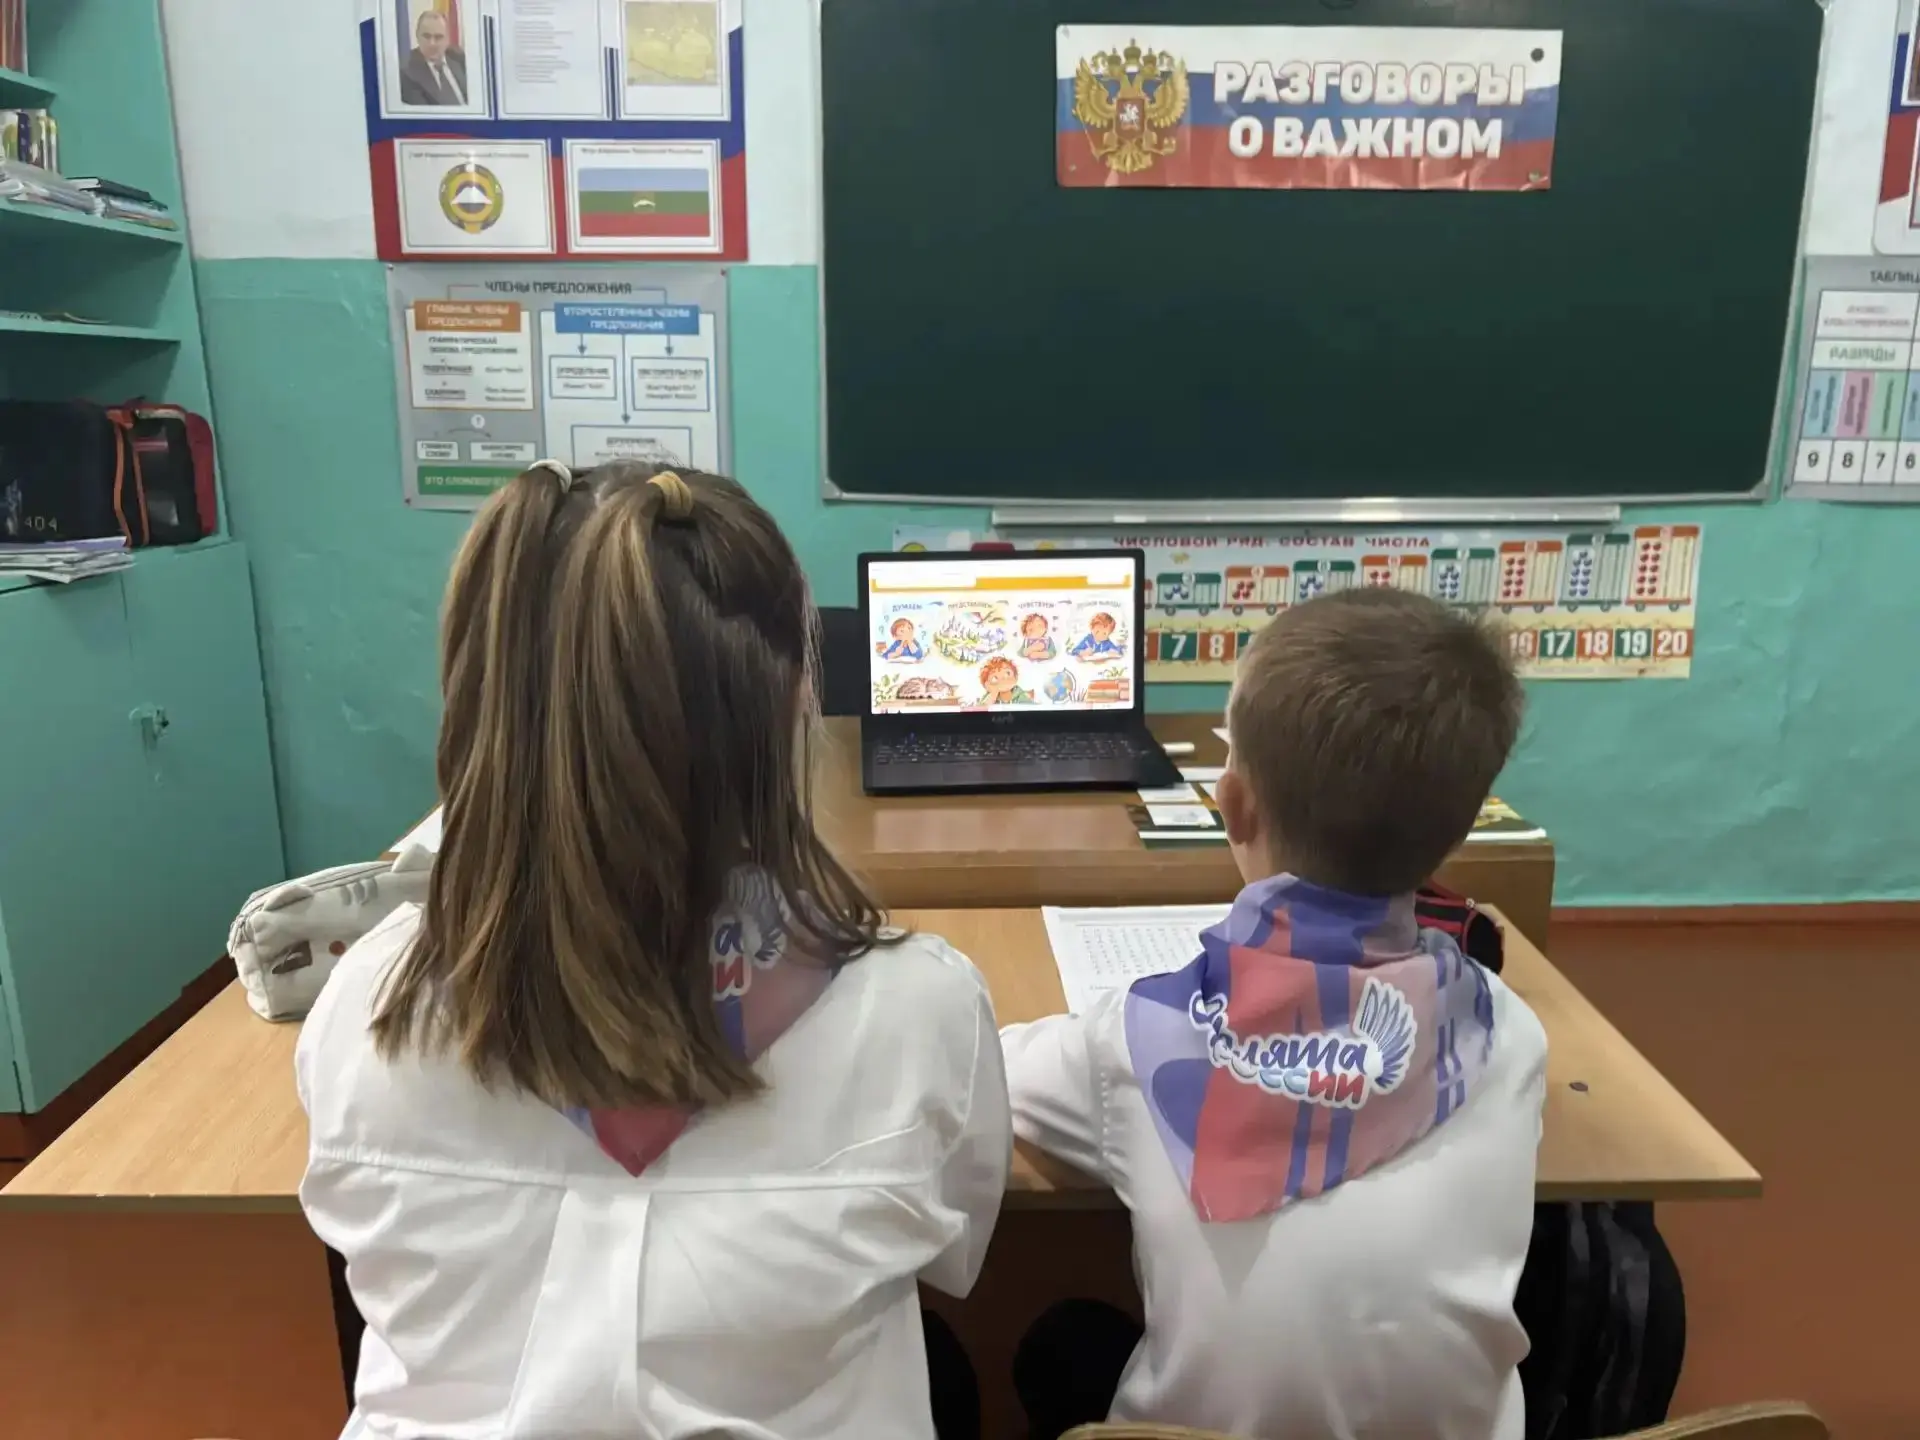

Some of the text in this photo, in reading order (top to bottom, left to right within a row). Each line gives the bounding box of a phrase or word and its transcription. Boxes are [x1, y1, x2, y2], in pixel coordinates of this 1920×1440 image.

[1214, 61, 1527, 106] РАЗГОВОРЫ
[1228, 116, 1503, 159] О ВАЖНОМ
[485, 281, 632, 295] ЧЛЕНЫ ПРЕДЛОЖЕНИЯ
[590, 320, 666, 331] ПРЕДЛОЖЕНИЯ
[1808, 451, 1819, 468] 9
[1842, 451, 1853, 469] 8
[1876, 452, 1886, 470] 7
[1113, 535, 1218, 548] ЧИСЛОВОЙ
[1279, 535, 1355, 548] СОСТАВ
[1365, 535, 1431, 548] ЧИСЛА
[1171, 634, 1187, 659] 7
[1209, 634, 1225, 659] 8
[1544, 631, 1571, 656] 17
[1582, 630, 1609, 656] 18
[1620, 630, 1647, 656] 19
[1657, 630, 1687, 656] 20
